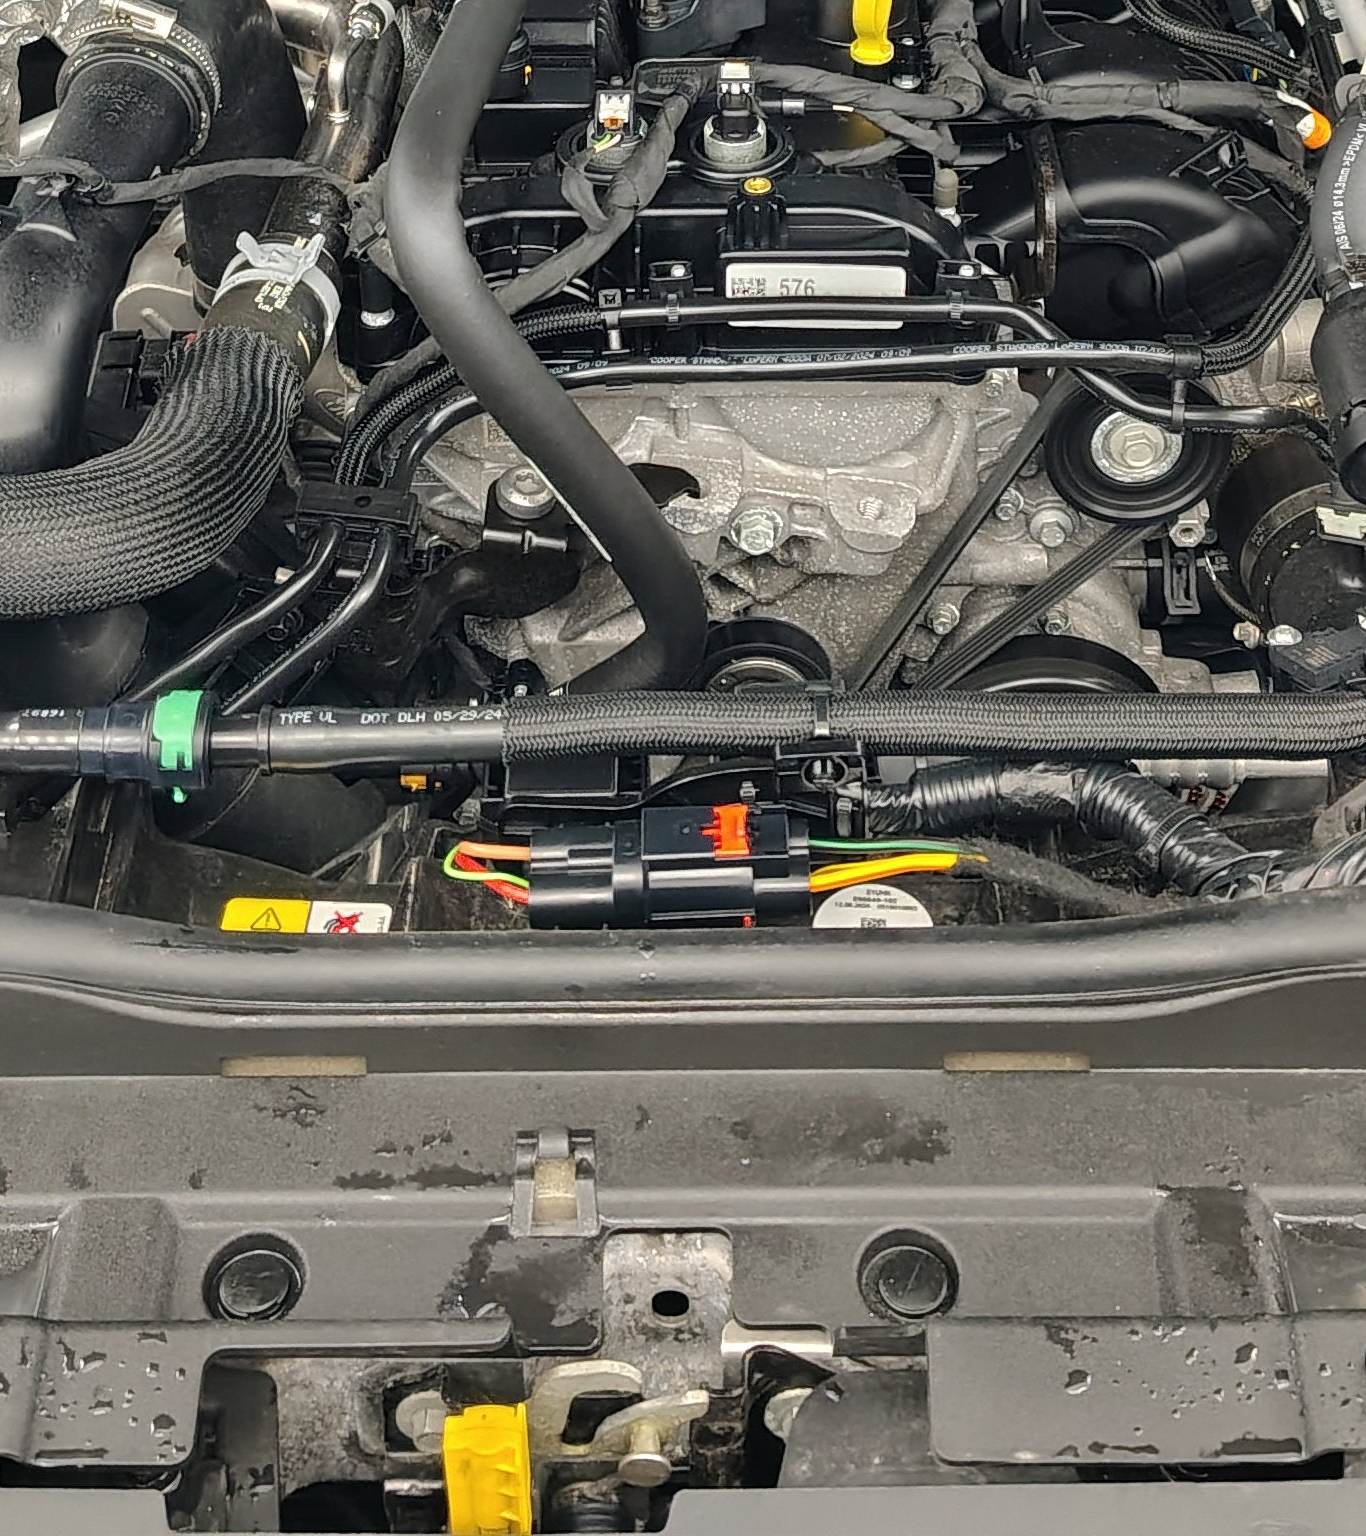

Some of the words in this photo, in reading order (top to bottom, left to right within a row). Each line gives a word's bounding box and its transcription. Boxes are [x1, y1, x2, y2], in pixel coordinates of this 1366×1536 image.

[779, 278, 816, 297] 576
[952, 344, 991, 354] COOPER
[649, 356, 687, 365] COOPER
[279, 710, 313, 725] TYPE
[361, 712, 389, 725] DOT
[397, 711, 425, 723] DLH
[434, 709, 502, 721] 05/29/24
